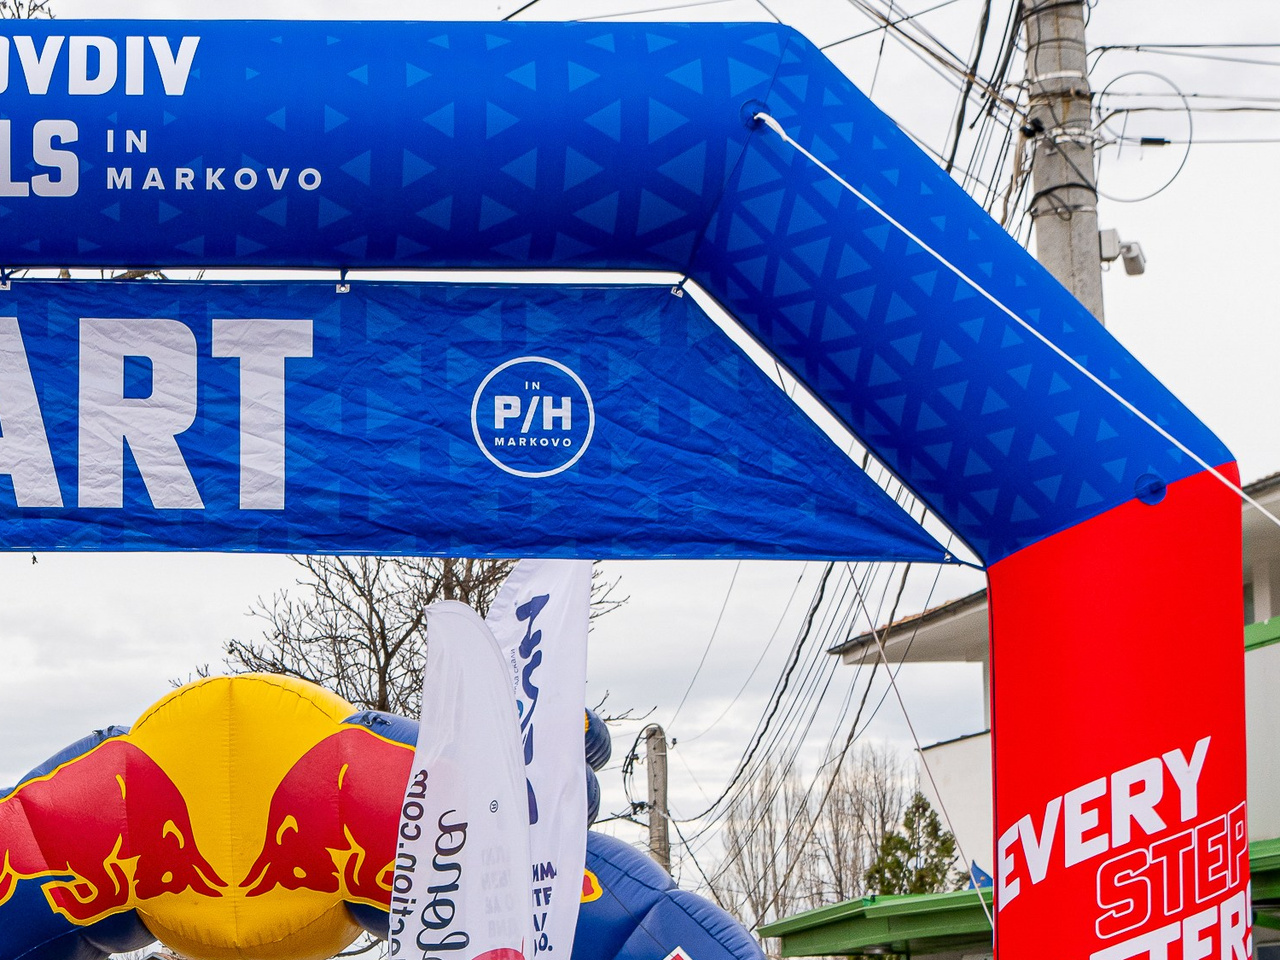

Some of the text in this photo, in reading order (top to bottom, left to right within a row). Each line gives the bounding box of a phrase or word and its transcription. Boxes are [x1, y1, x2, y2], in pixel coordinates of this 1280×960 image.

[106, 130, 147, 153] IN
[106, 167, 323, 191] MARKOVO
[525, 381, 540, 390] IN
[495, 395, 571, 433] P/H
[495, 437, 572, 447] MARKOVO
[998, 735, 1211, 912] EVERY
[1095, 800, 1247, 939] STEP
